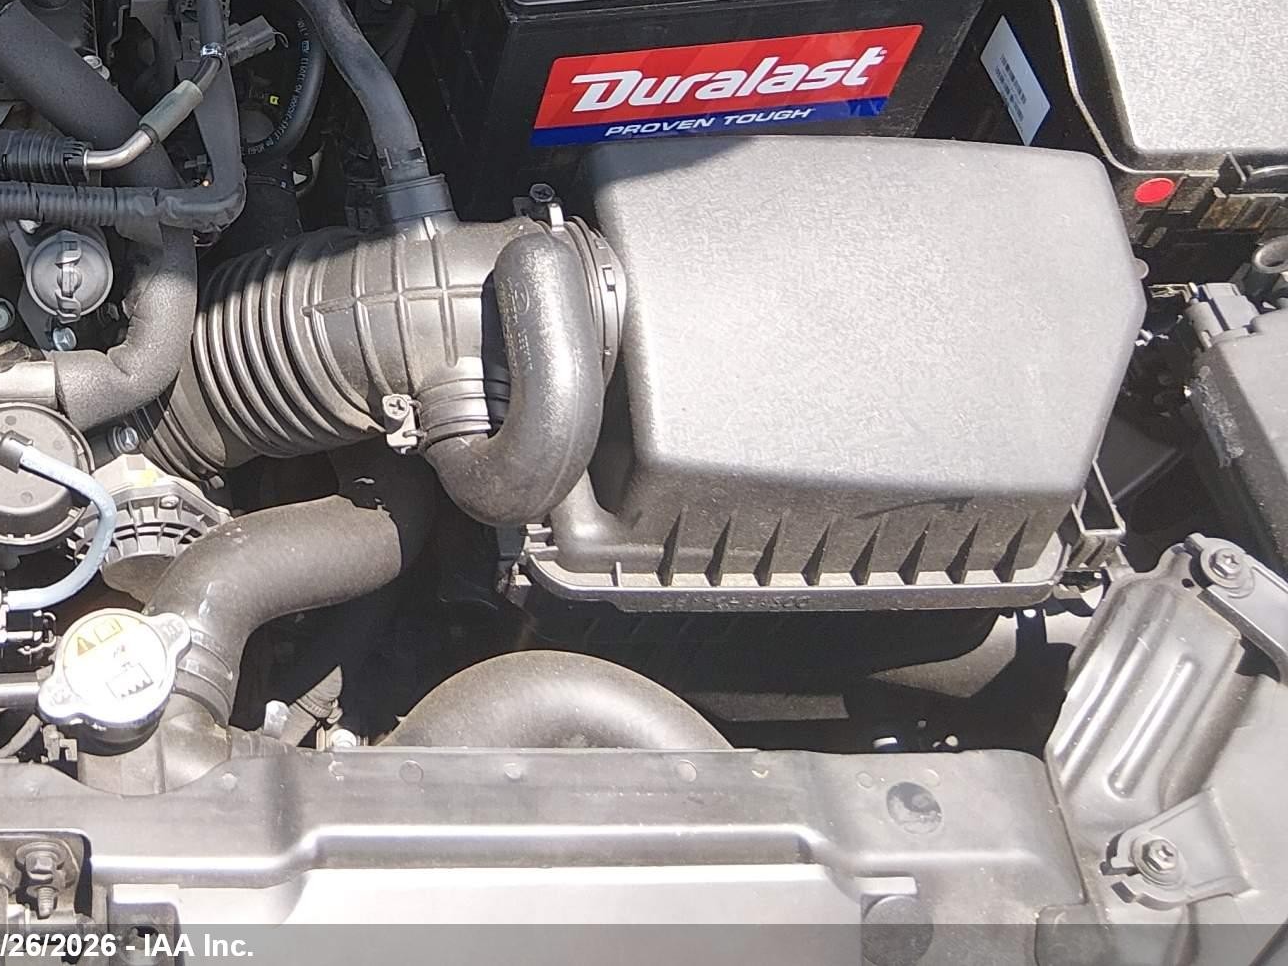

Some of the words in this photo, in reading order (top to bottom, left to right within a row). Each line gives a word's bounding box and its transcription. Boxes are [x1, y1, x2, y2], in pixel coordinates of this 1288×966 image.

[571, 45, 885, 113] Duralast
[605, 117, 719, 137] PROVEN
[723, 107, 812, 126] TOUGH
